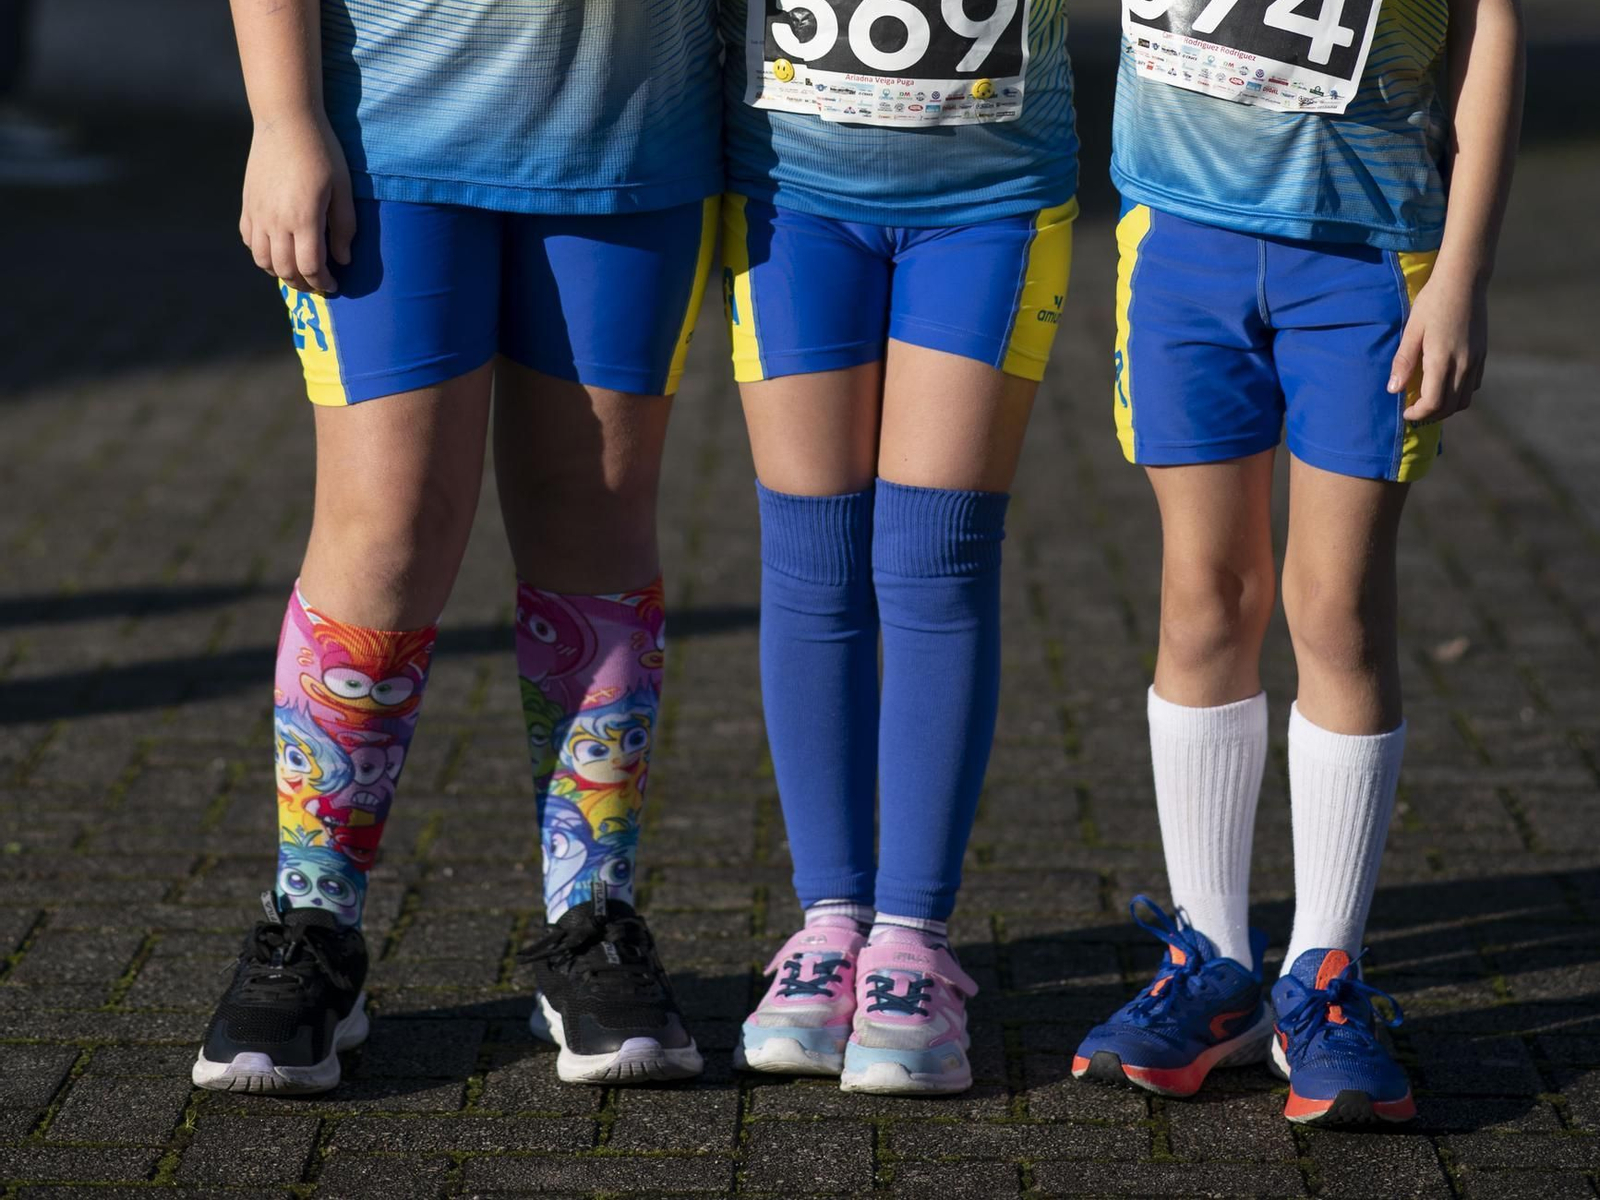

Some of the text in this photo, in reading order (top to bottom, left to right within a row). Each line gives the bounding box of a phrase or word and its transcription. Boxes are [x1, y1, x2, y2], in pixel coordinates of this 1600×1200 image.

[845, 73, 914, 87] Ariadna Veiga Puga
